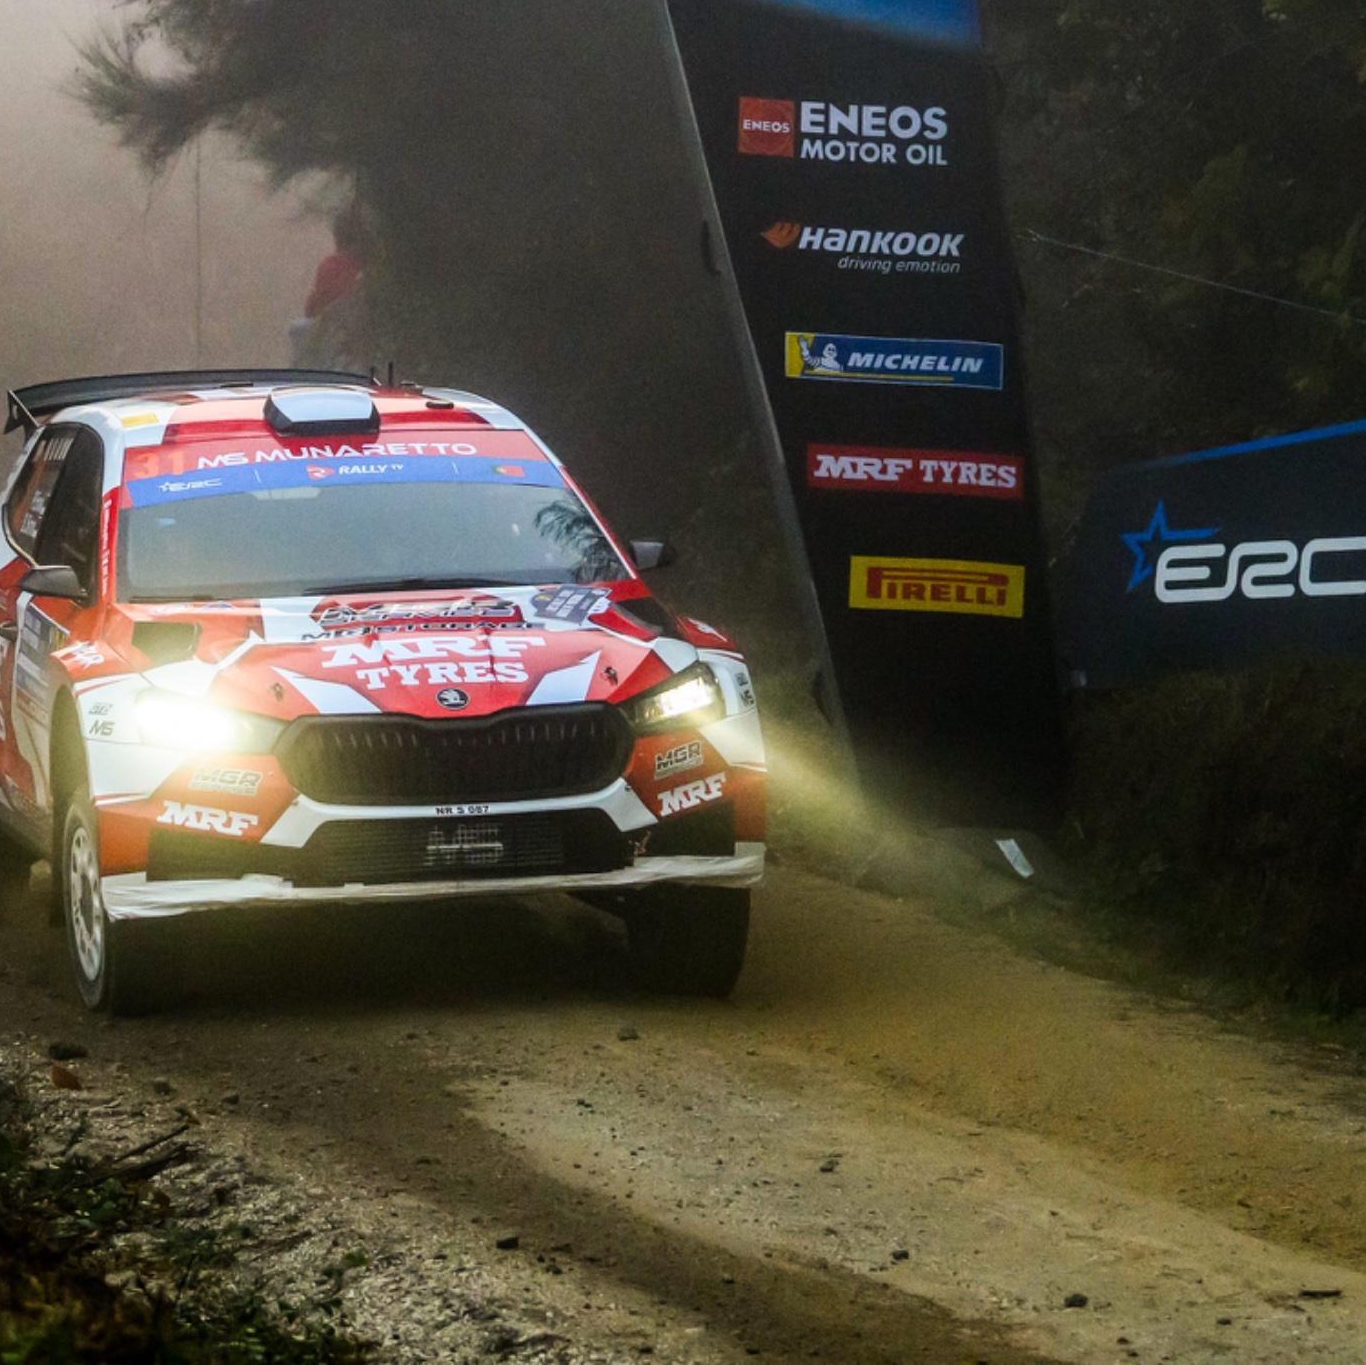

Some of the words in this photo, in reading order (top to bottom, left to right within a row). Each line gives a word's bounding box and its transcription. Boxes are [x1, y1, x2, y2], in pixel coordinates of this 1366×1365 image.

[742, 120, 790, 133] ENEOS
[801, 101, 948, 139] ENEOS
[801, 140, 896, 163] MOTOR
[906, 144, 947, 166] OIL
[838, 256, 892, 275] driving
[896, 259, 961, 273] emotion
[847, 351, 983, 374] MICHELIN
[136, 452, 184, 480] 31
[197, 452, 249, 470] MS
[255, 442, 477, 463] MUNARETTO
[338, 463, 388, 475] RALLY
[814, 454, 913, 482] MRF
[919, 459, 1017, 489] TYRES
[866, 566, 1010, 607] PIRELLI
[321, 636, 546, 668] MRF
[357, 661, 529, 690] TYRES
[657, 772, 726, 817] MRF
[156, 800, 259, 836] MRF
